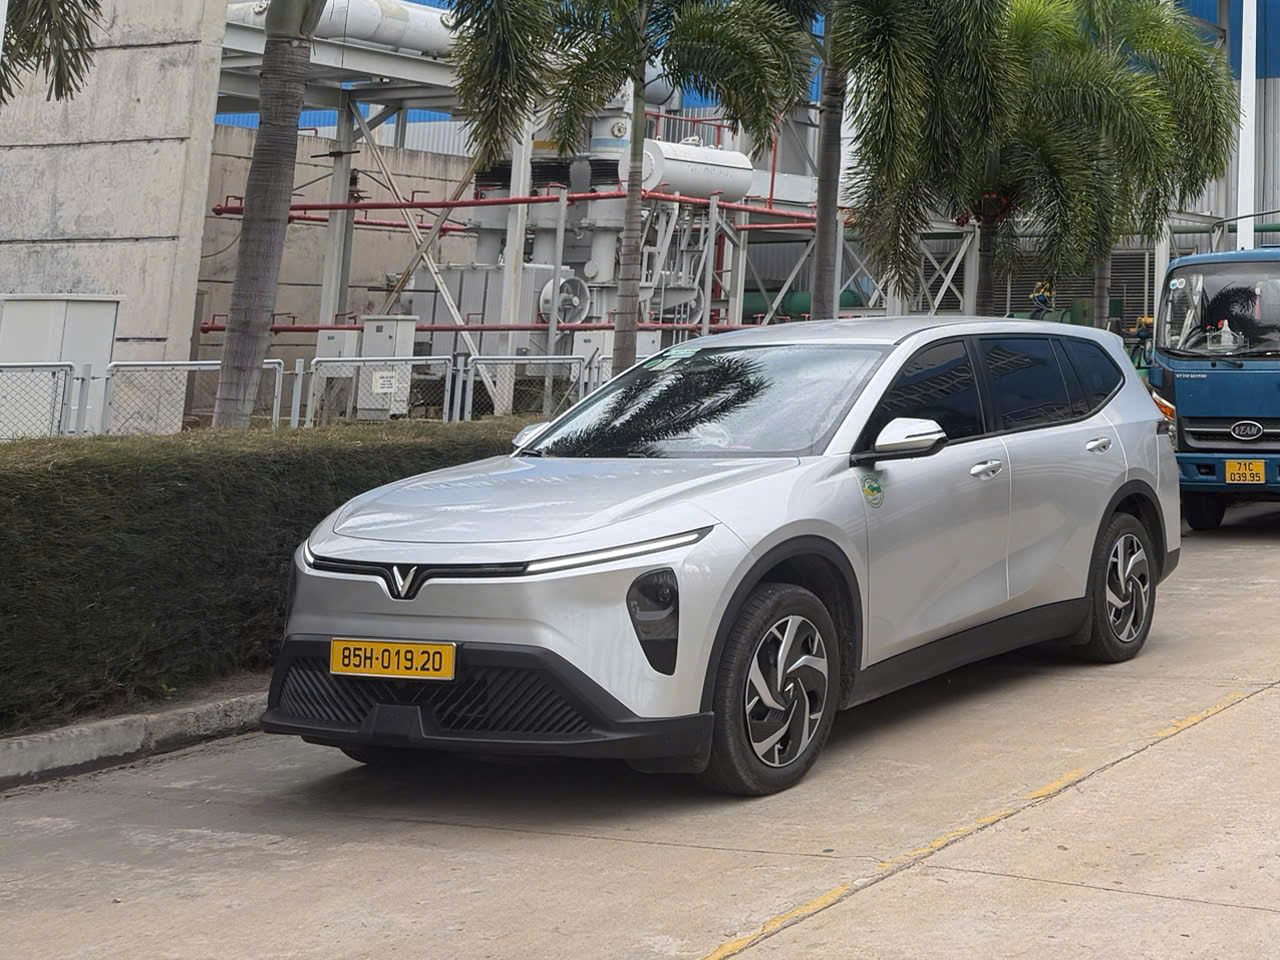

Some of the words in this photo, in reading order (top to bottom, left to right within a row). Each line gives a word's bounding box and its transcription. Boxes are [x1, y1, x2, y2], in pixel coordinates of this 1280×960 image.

[1234, 426, 1258, 435] VEAM
[1237, 462, 1254, 471] 71C
[1230, 472, 1261, 482] 039.95
[341, 646, 443, 672] 85H-019.20
